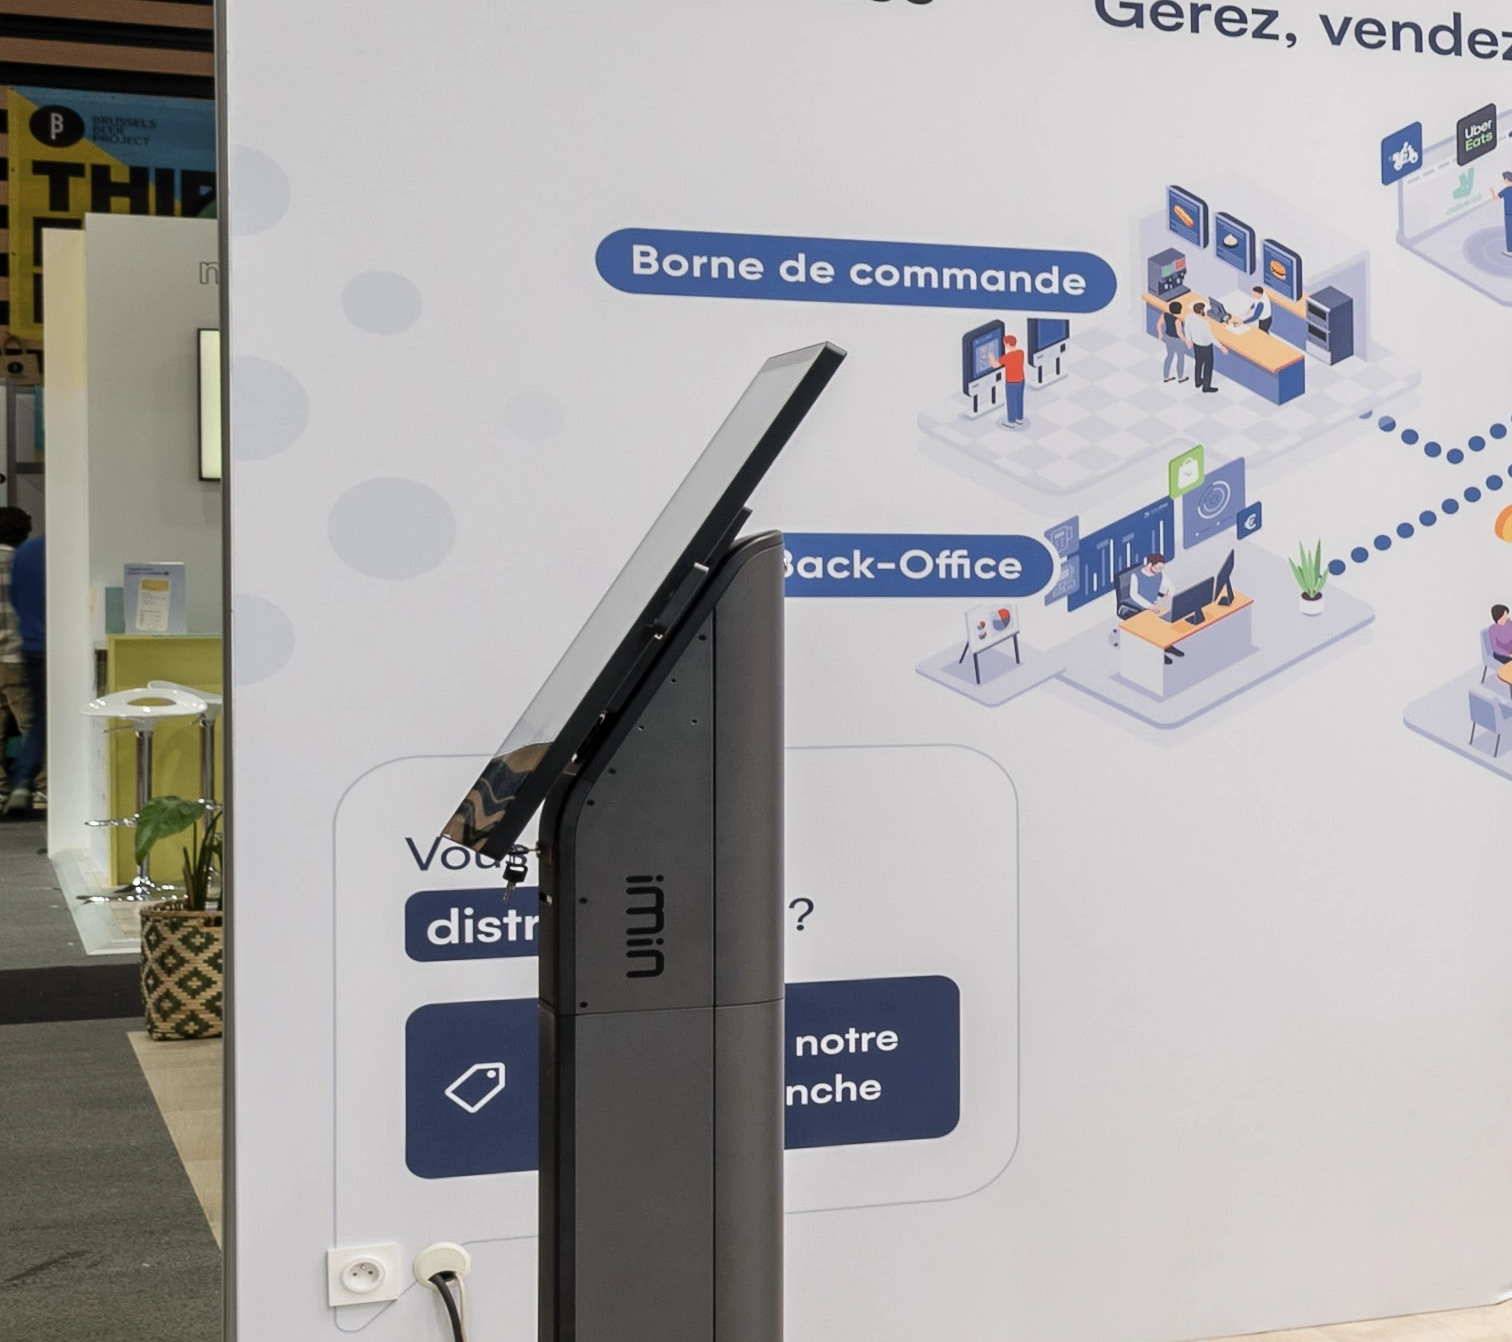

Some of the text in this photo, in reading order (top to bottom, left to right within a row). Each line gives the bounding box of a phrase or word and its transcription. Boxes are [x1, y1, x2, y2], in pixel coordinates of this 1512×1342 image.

[1465, 119, 1493, 139] Uber
[1465, 131, 1494, 151] Eats
[631, 243, 1087, 296] Borne de commande
[788, 897, 816, 931] ?
[796, 1025, 900, 1059] notre
